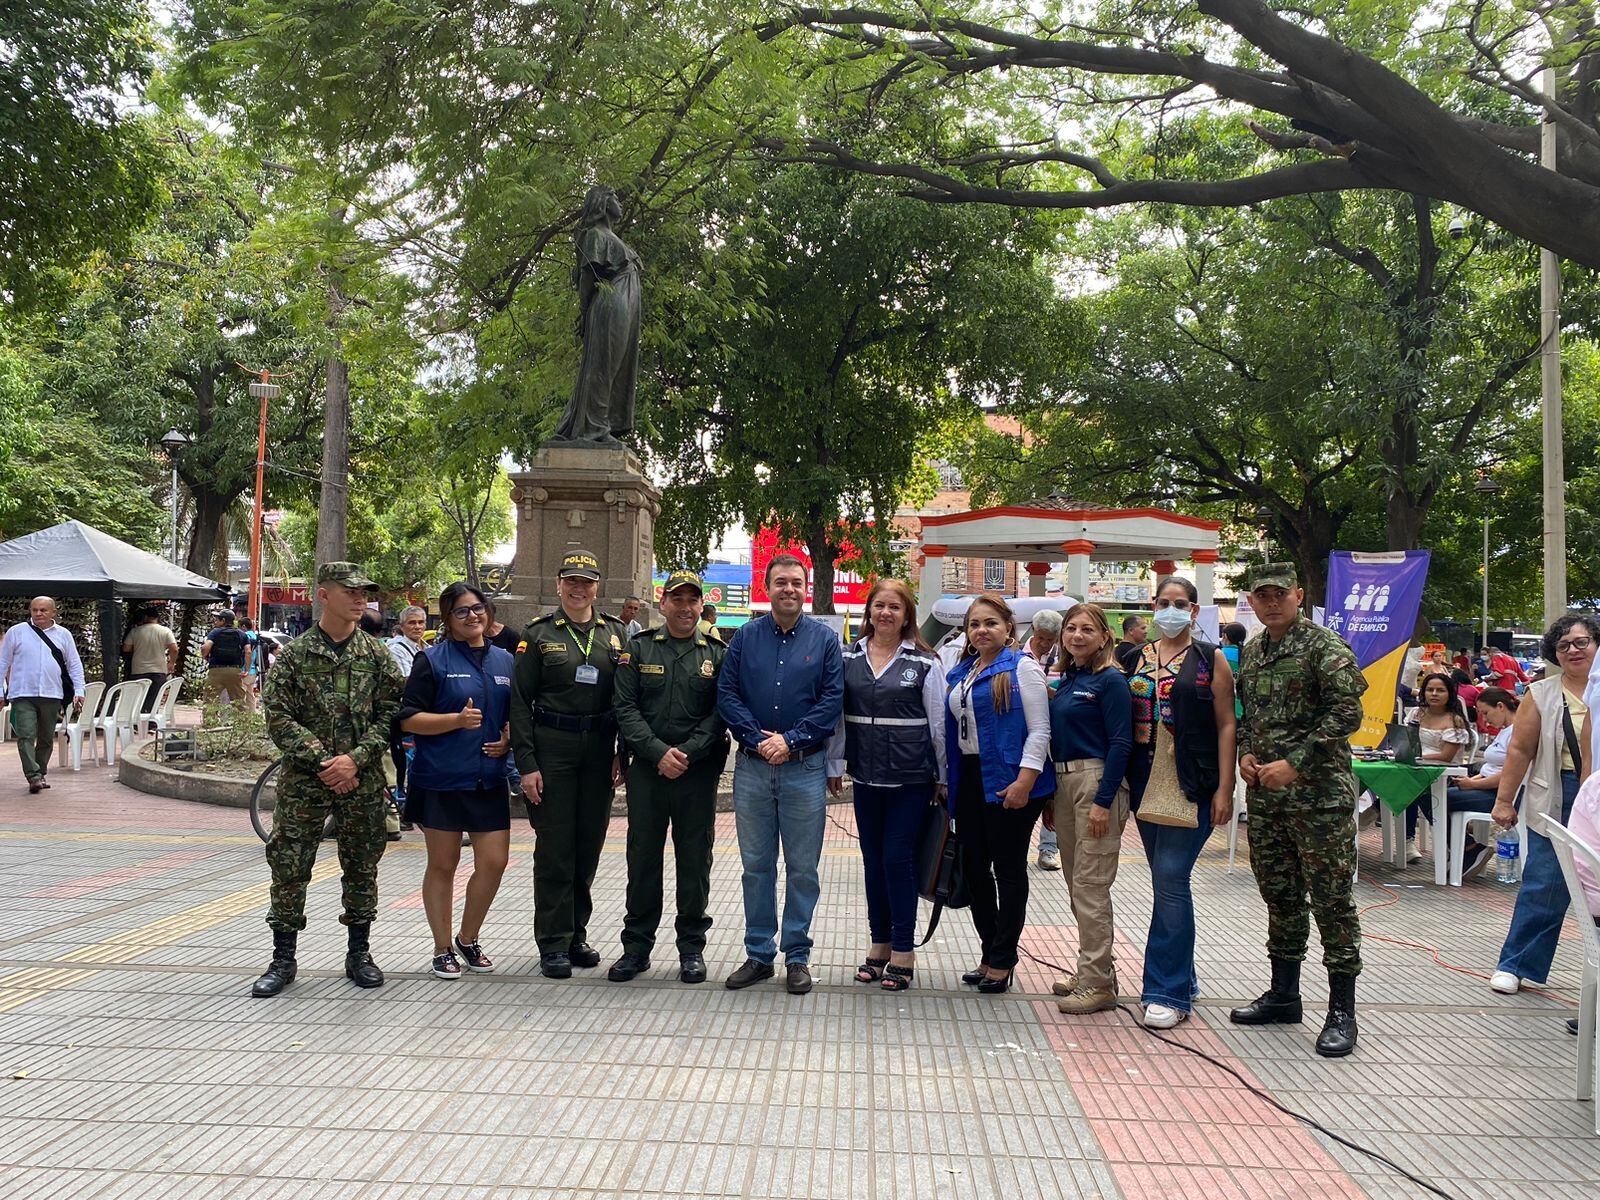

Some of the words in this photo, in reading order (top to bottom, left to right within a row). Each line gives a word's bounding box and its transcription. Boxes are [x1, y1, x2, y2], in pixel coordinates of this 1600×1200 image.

[564, 555, 597, 567] POLICIA
[1347, 623, 1360, 631] DE
[1359, 623, 1388, 632] EMPLEO
